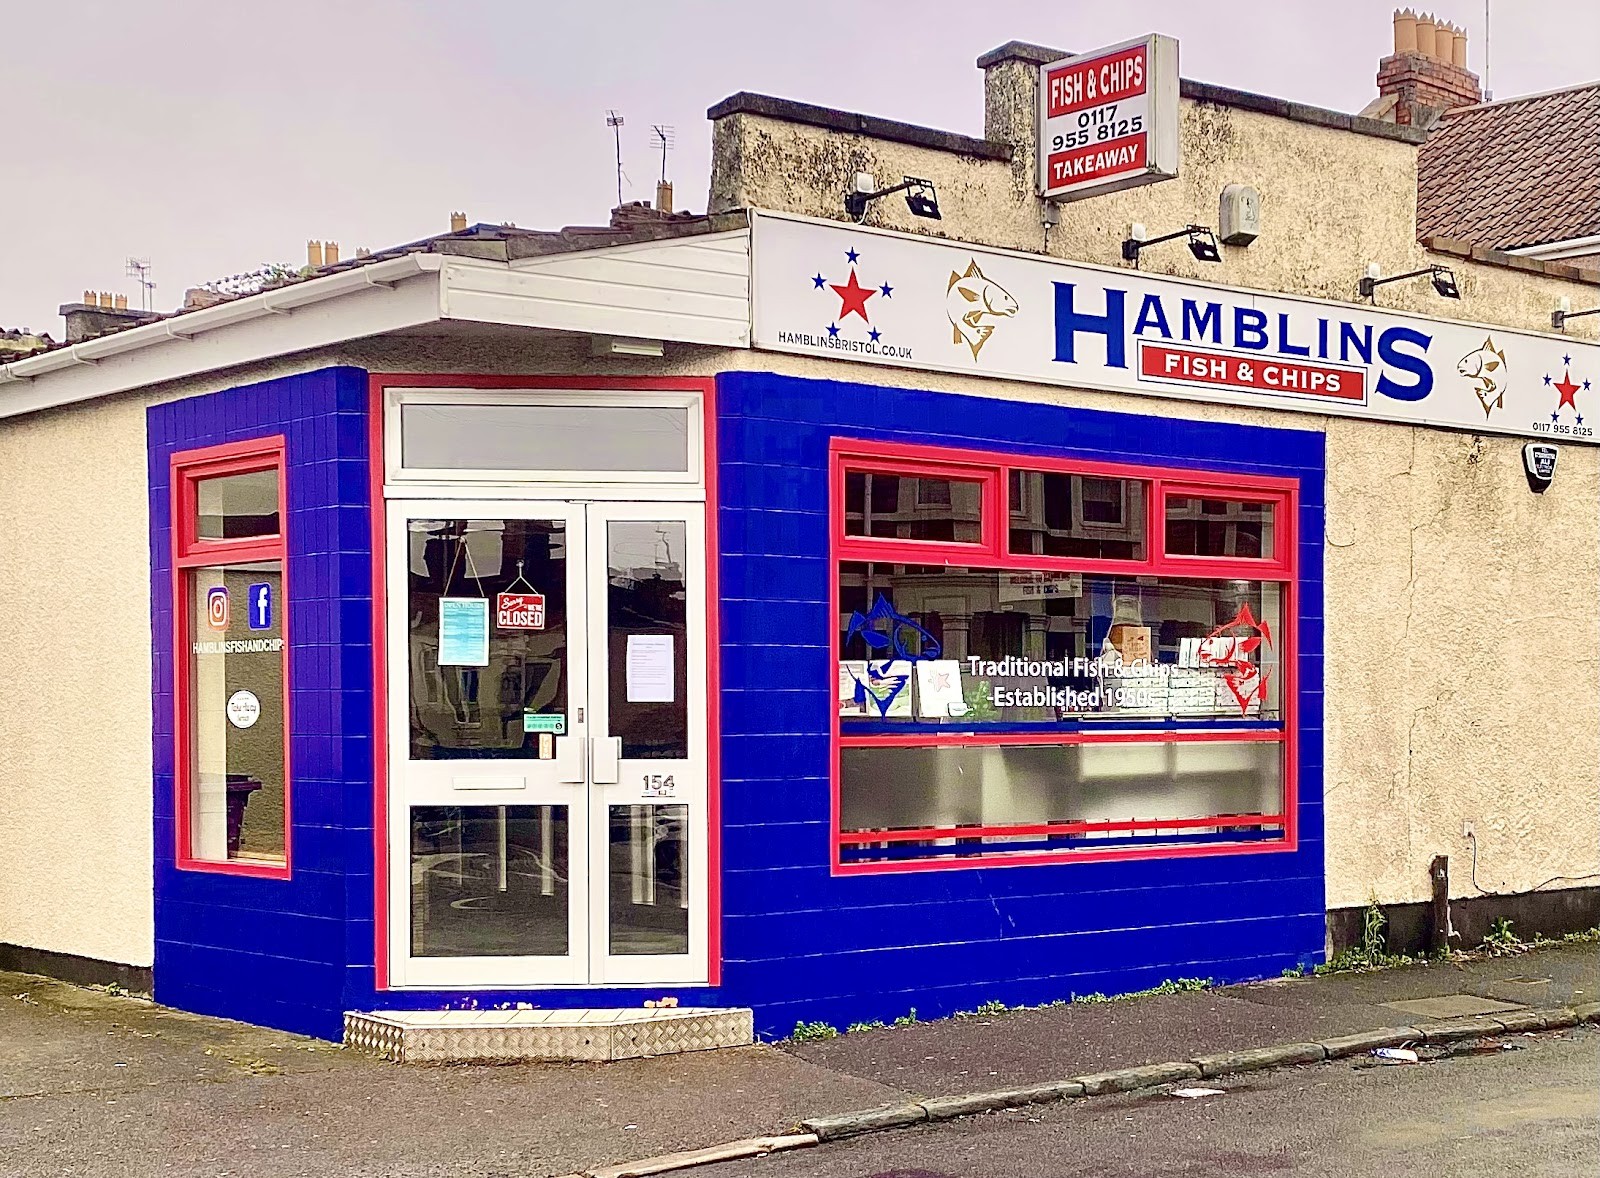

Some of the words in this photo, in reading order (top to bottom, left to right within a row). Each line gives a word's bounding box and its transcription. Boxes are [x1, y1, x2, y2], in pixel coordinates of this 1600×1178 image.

[1051, 70, 1083, 109] FISH
[1087, 68, 1097, 100] &
[1100, 55, 1143, 96] CHIPS
[1078, 105, 1118, 128] 0117
[1052, 129, 1089, 151] 955
[1097, 115, 1142, 141] 8125
[1053, 144, 1139, 180] TAKEAWAY
[779, 331, 912, 359] HAMBLINSBRISTOL.CO.UK
[1050, 281, 1434, 401] HAMBLINS
[1165, 354, 1227, 380] FISH
[1237, 362, 1254, 383] &
[1263, 366, 1341, 392] CHIPS
[1532, 422, 1550, 432] 0117
[1553, 425, 1570, 434] 955
[1573, 427, 1593, 436] 8125
[499, 611, 542, 626] CLOSED
[967, 656, 1069, 677] Traditional
[1073, 656, 1109, 677] Fish
[1114, 657, 1127, 678] &
[1131, 658, 1179, 683] Chips
[643, 775, 675, 791] 154
